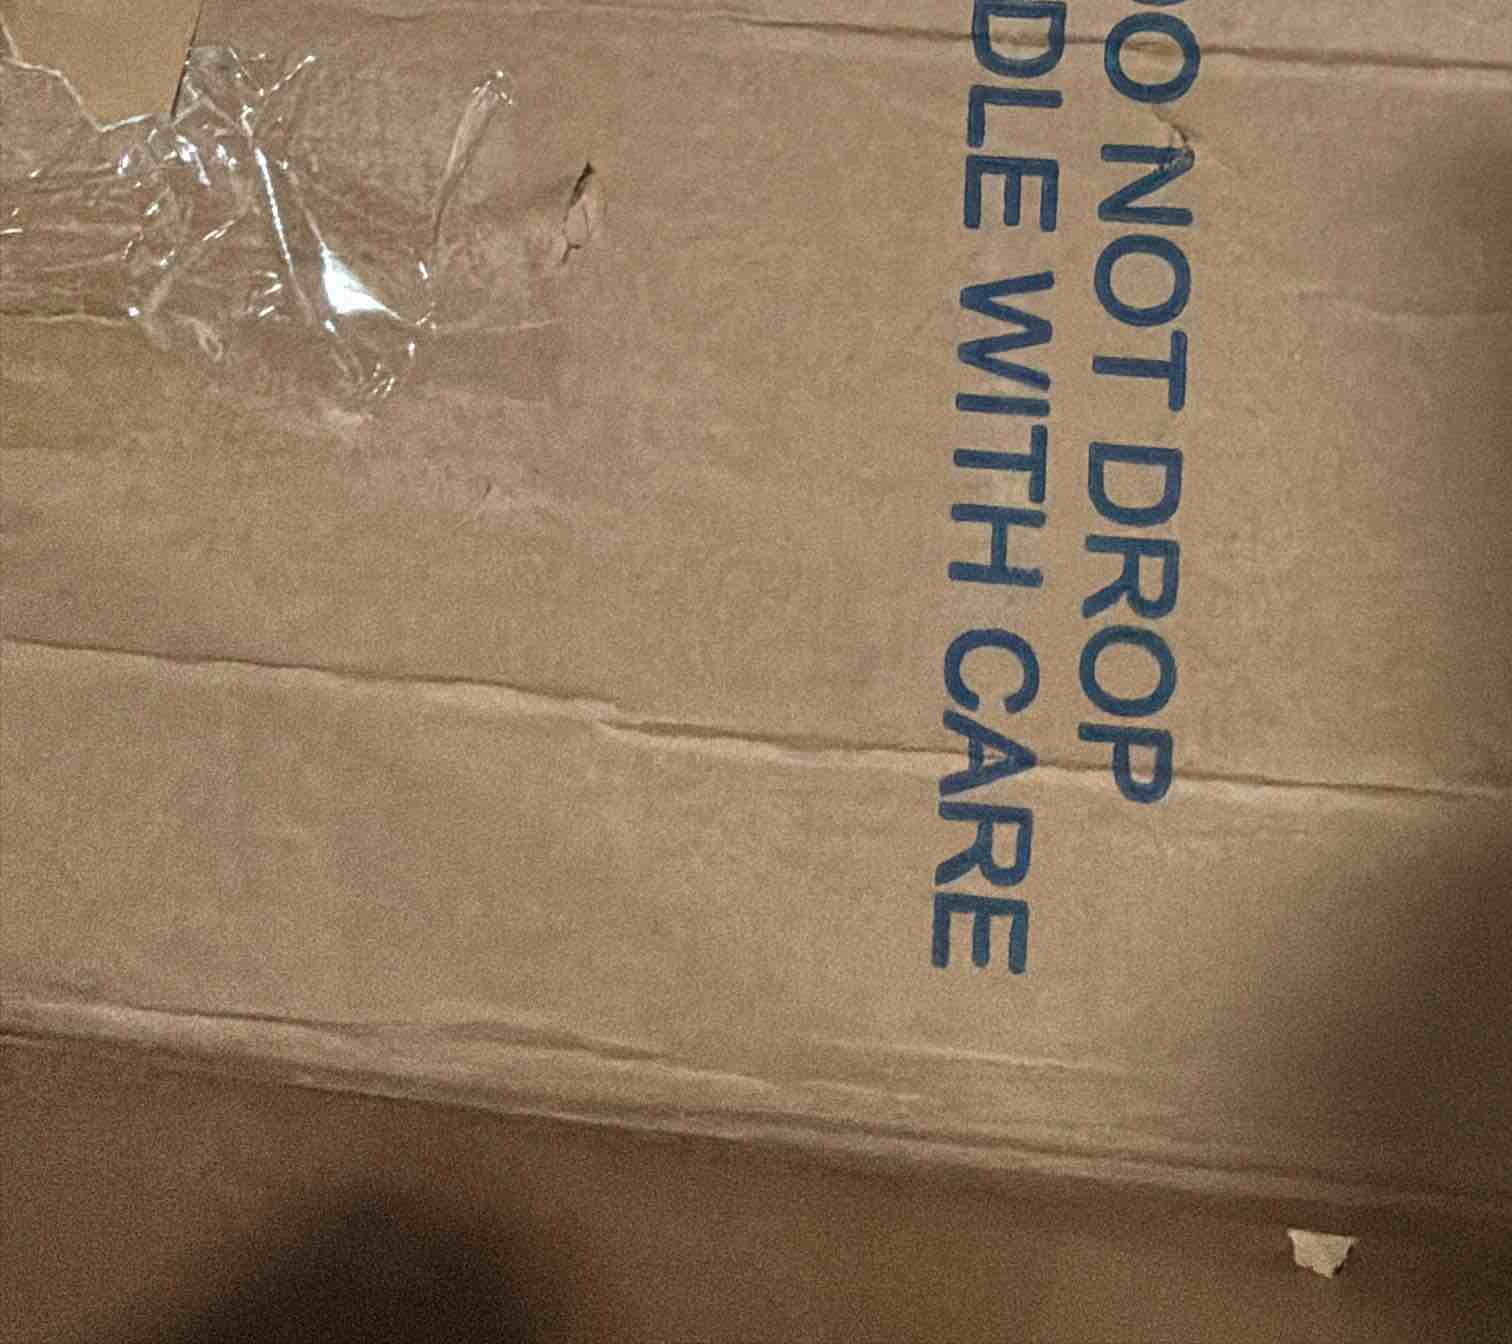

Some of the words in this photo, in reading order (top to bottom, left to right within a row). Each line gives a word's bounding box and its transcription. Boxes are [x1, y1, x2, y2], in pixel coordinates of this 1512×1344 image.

[950, 272, 1052, 587] WITH
[1093, 144, 1194, 411] NOT
[1077, 442, 1183, 803] DROP
[934, 630, 1039, 971] CARE
